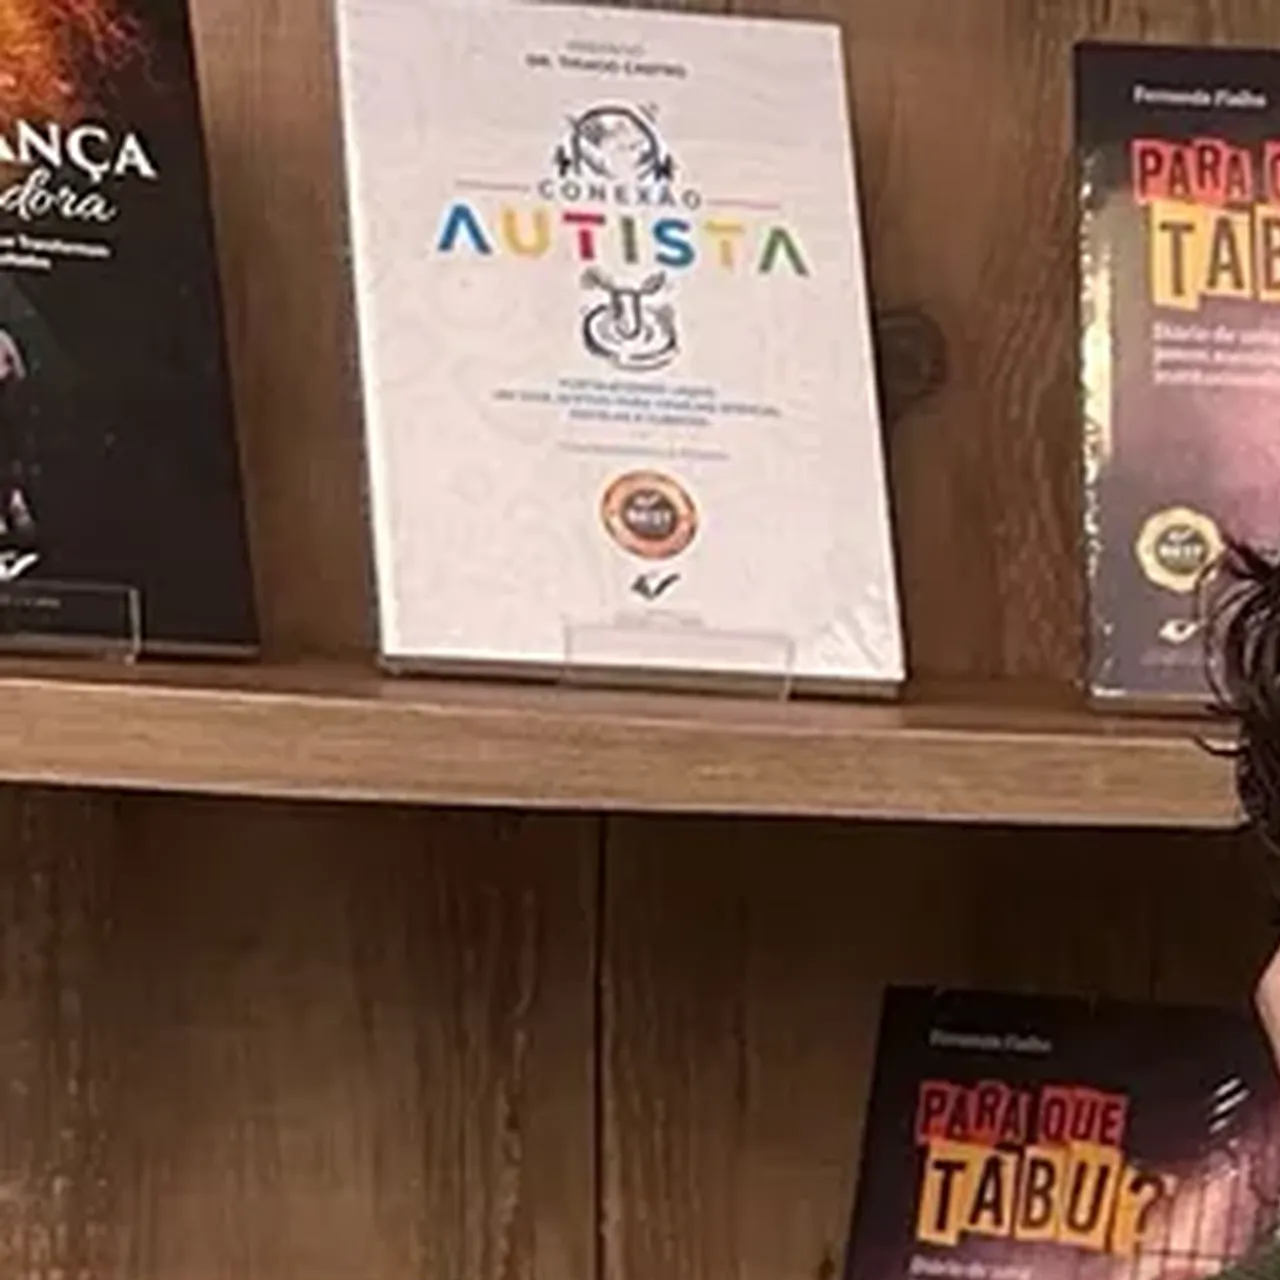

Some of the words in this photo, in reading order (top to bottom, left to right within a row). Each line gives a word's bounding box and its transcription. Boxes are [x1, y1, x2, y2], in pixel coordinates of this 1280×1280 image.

[1138, 143, 1249, 199] PARA
[437, 203, 811, 278] AUTISTA
[920, 1085, 1024, 1143] PARA
[1041, 1095, 1123, 1145] QUE
